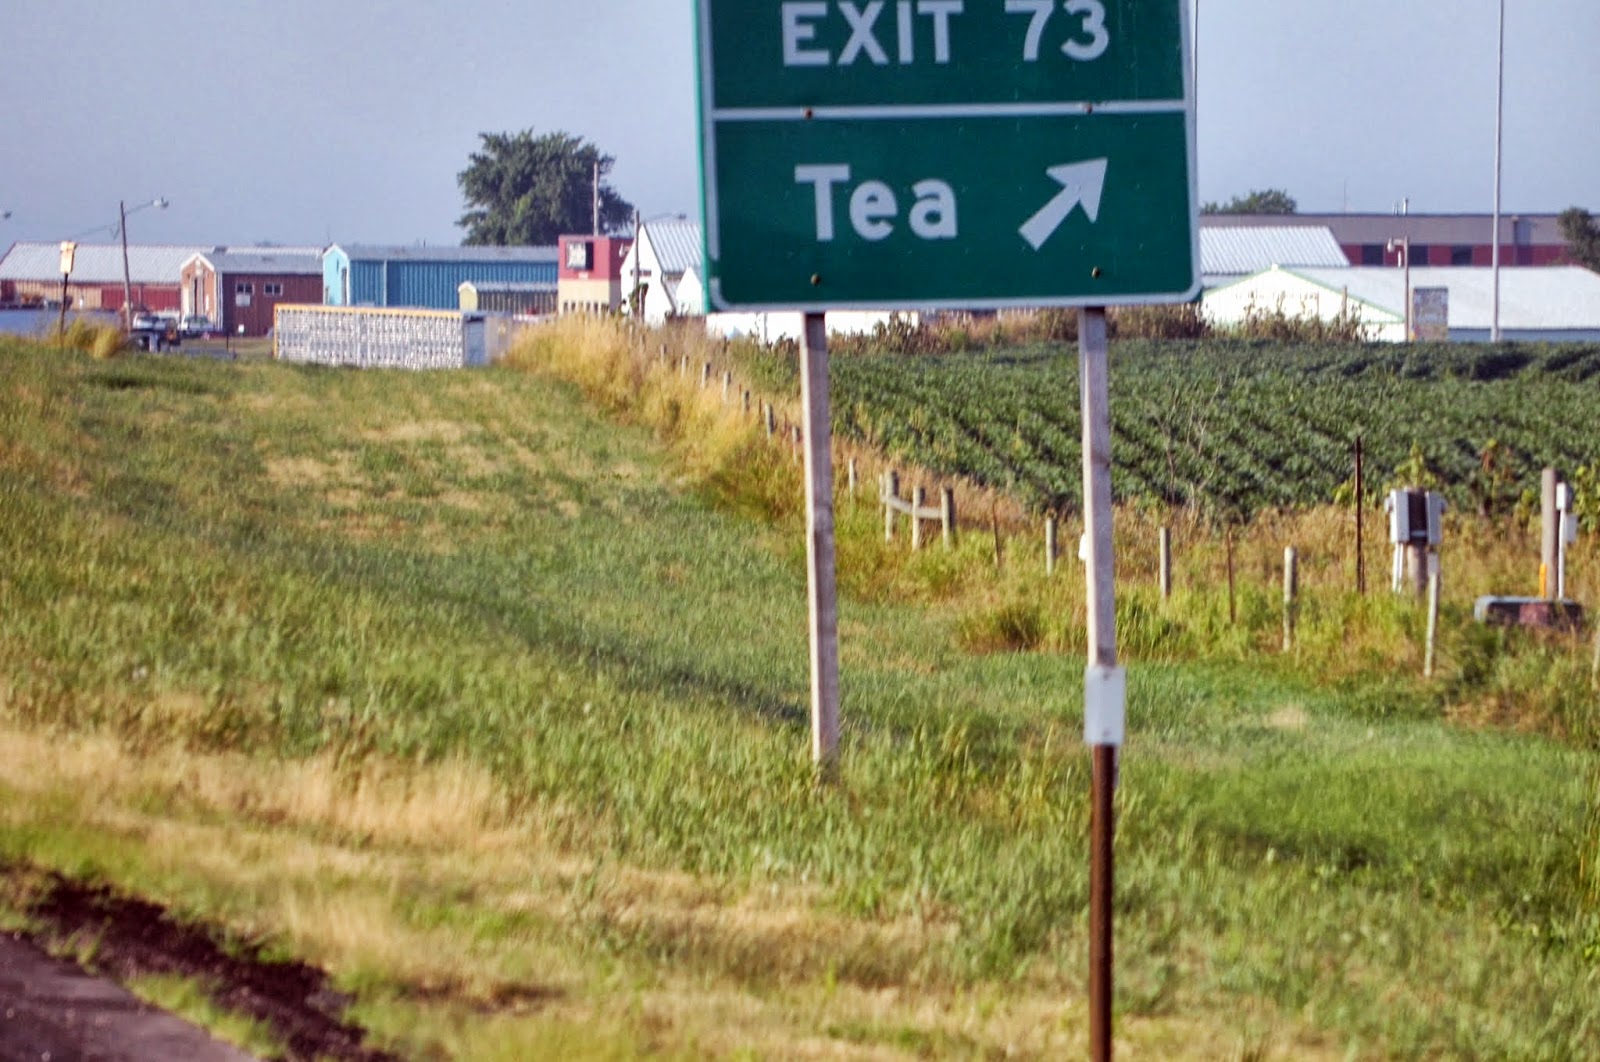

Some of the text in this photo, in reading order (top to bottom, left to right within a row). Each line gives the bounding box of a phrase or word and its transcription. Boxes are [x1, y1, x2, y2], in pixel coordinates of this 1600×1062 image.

[782, 0, 1110, 66] EXIT 73
[795, 163, 958, 241] Tea
